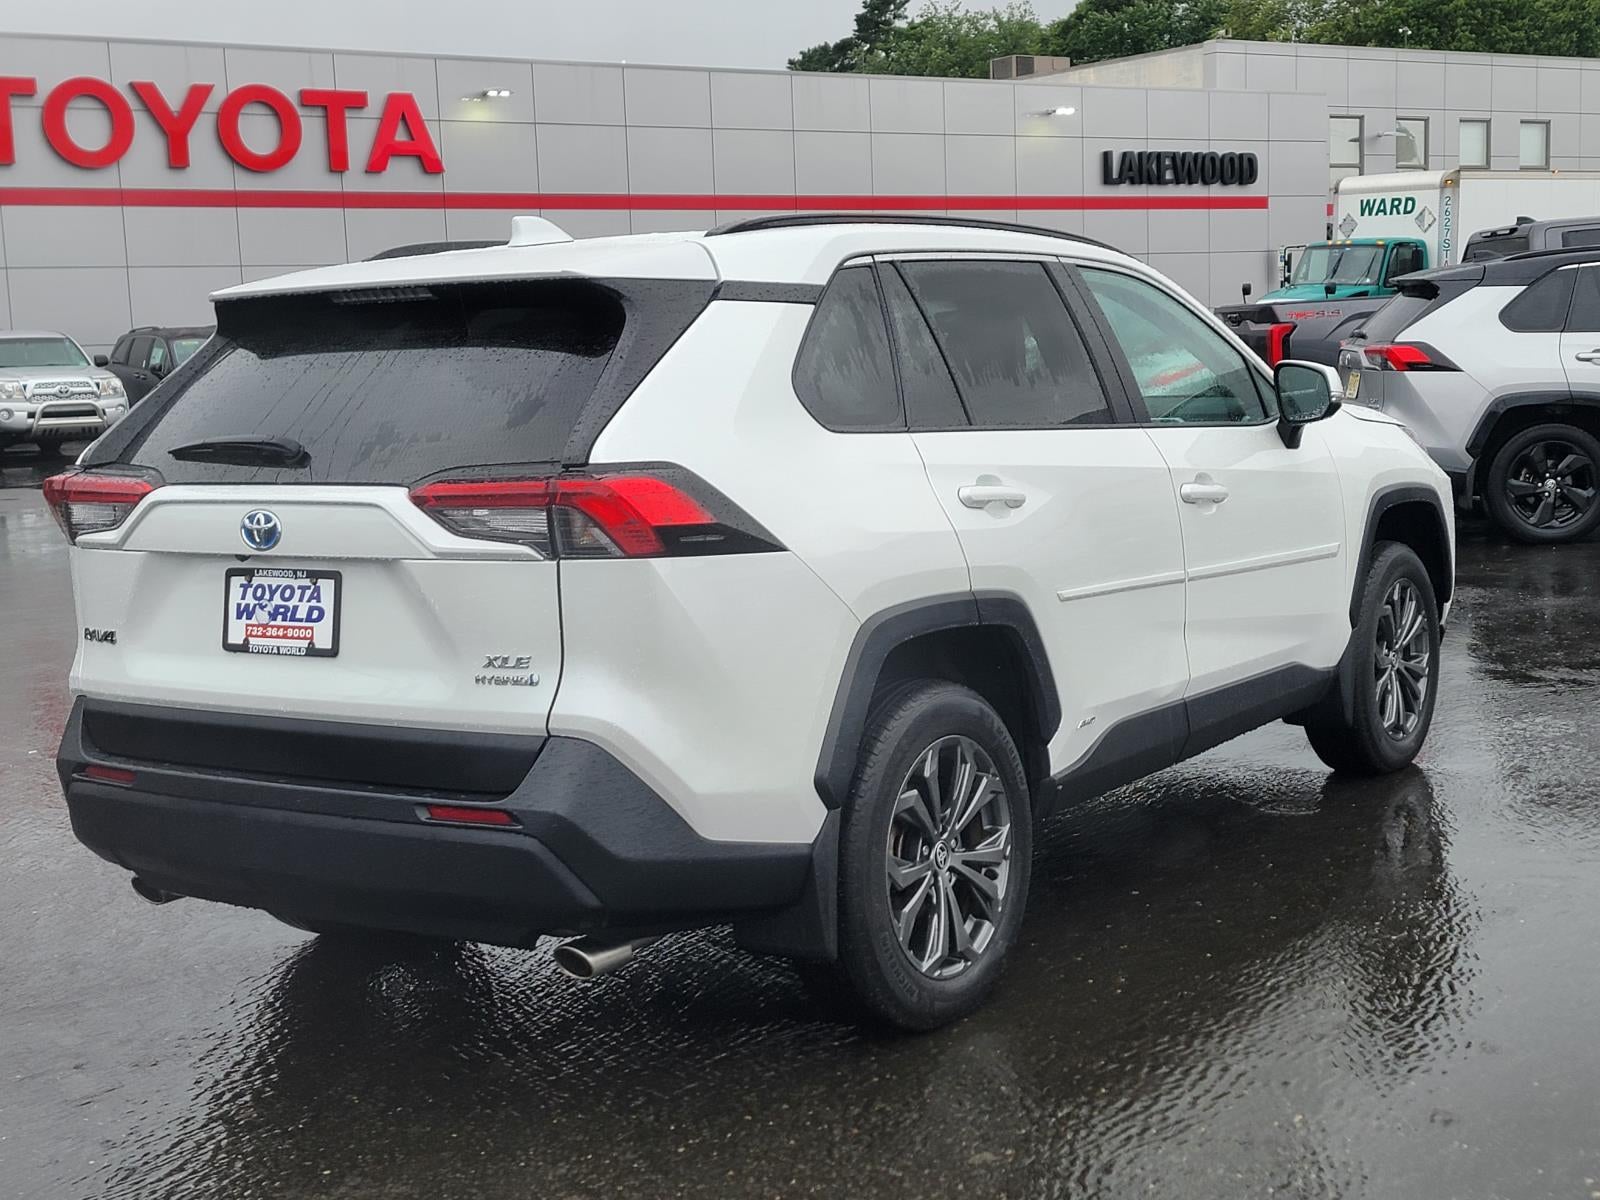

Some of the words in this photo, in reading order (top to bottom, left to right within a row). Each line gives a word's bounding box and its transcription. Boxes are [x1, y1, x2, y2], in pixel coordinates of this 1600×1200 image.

[0, 75, 446, 174] TOYOTA
[1102, 150, 1258, 186] LAKEWOOD
[1359, 196, 1417, 217] WARD
[254, 569, 296, 578] LAKEWOOD,
[297, 570, 307, 578] NJ
[239, 583, 322, 603] TOYOTA
[246, 626, 313, 638] 732-364-9000
[248, 644, 278, 655] TOYOTA
[279, 646, 307, 656] WORLD
[482, 655, 533, 669] XLE
